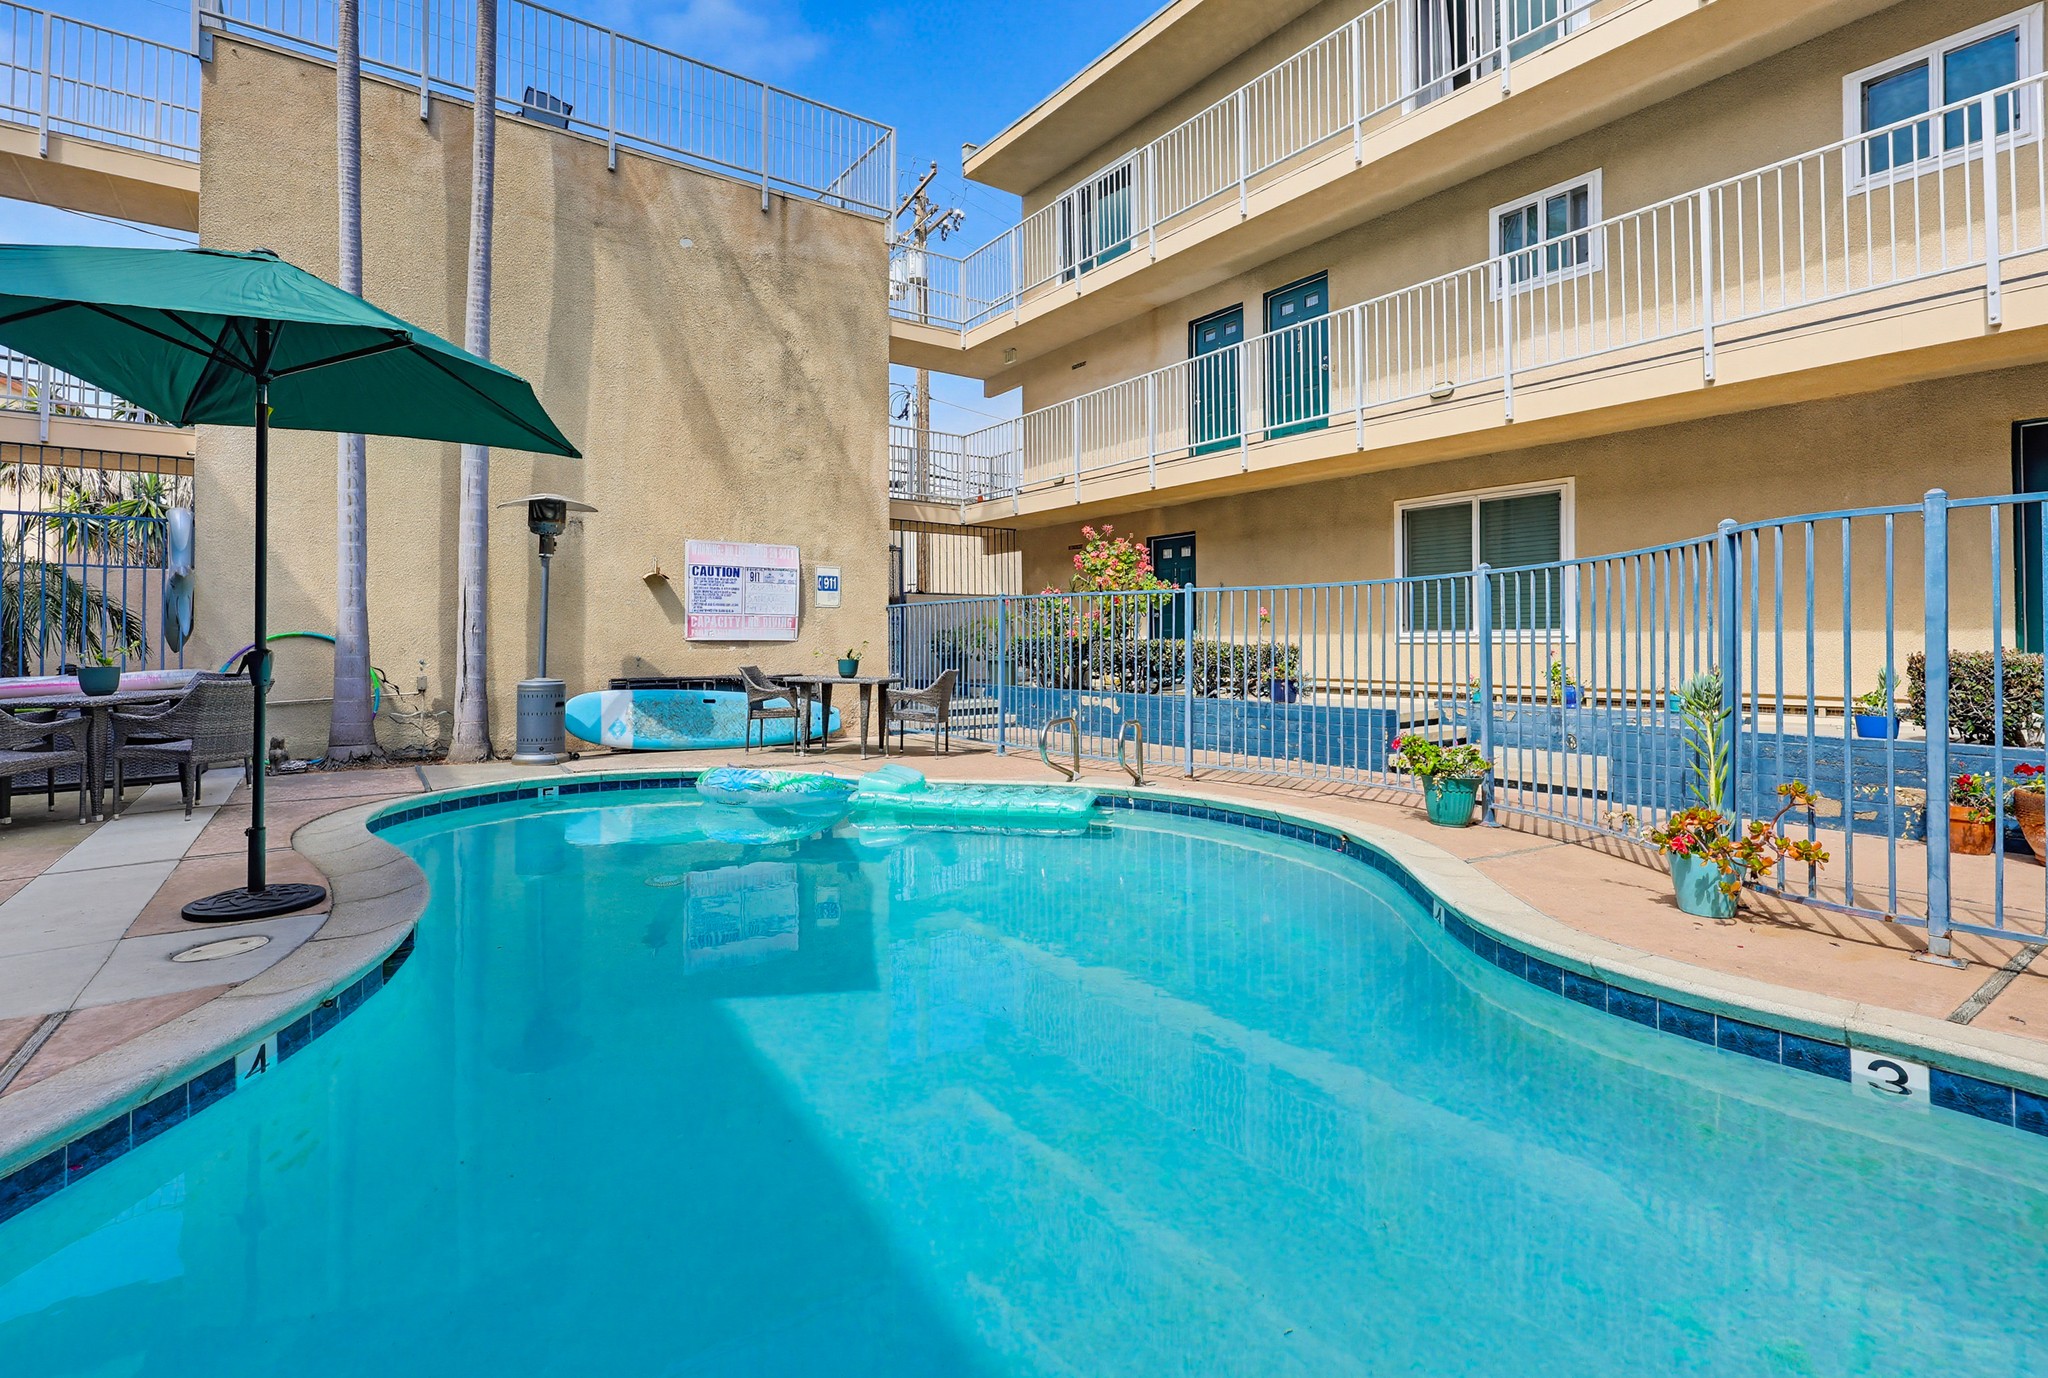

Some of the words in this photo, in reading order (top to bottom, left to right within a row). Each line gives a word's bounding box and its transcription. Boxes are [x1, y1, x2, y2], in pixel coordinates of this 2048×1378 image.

[692, 565, 740, 578] CAUTION
[750, 571, 760, 582] 911
[823, 577, 837, 590] 911
[690, 616, 741, 628] CAPACITY
[763, 617, 793, 629] DIVING
[244, 1043, 270, 1080] 4
[1868, 1060, 1913, 1096] 3
